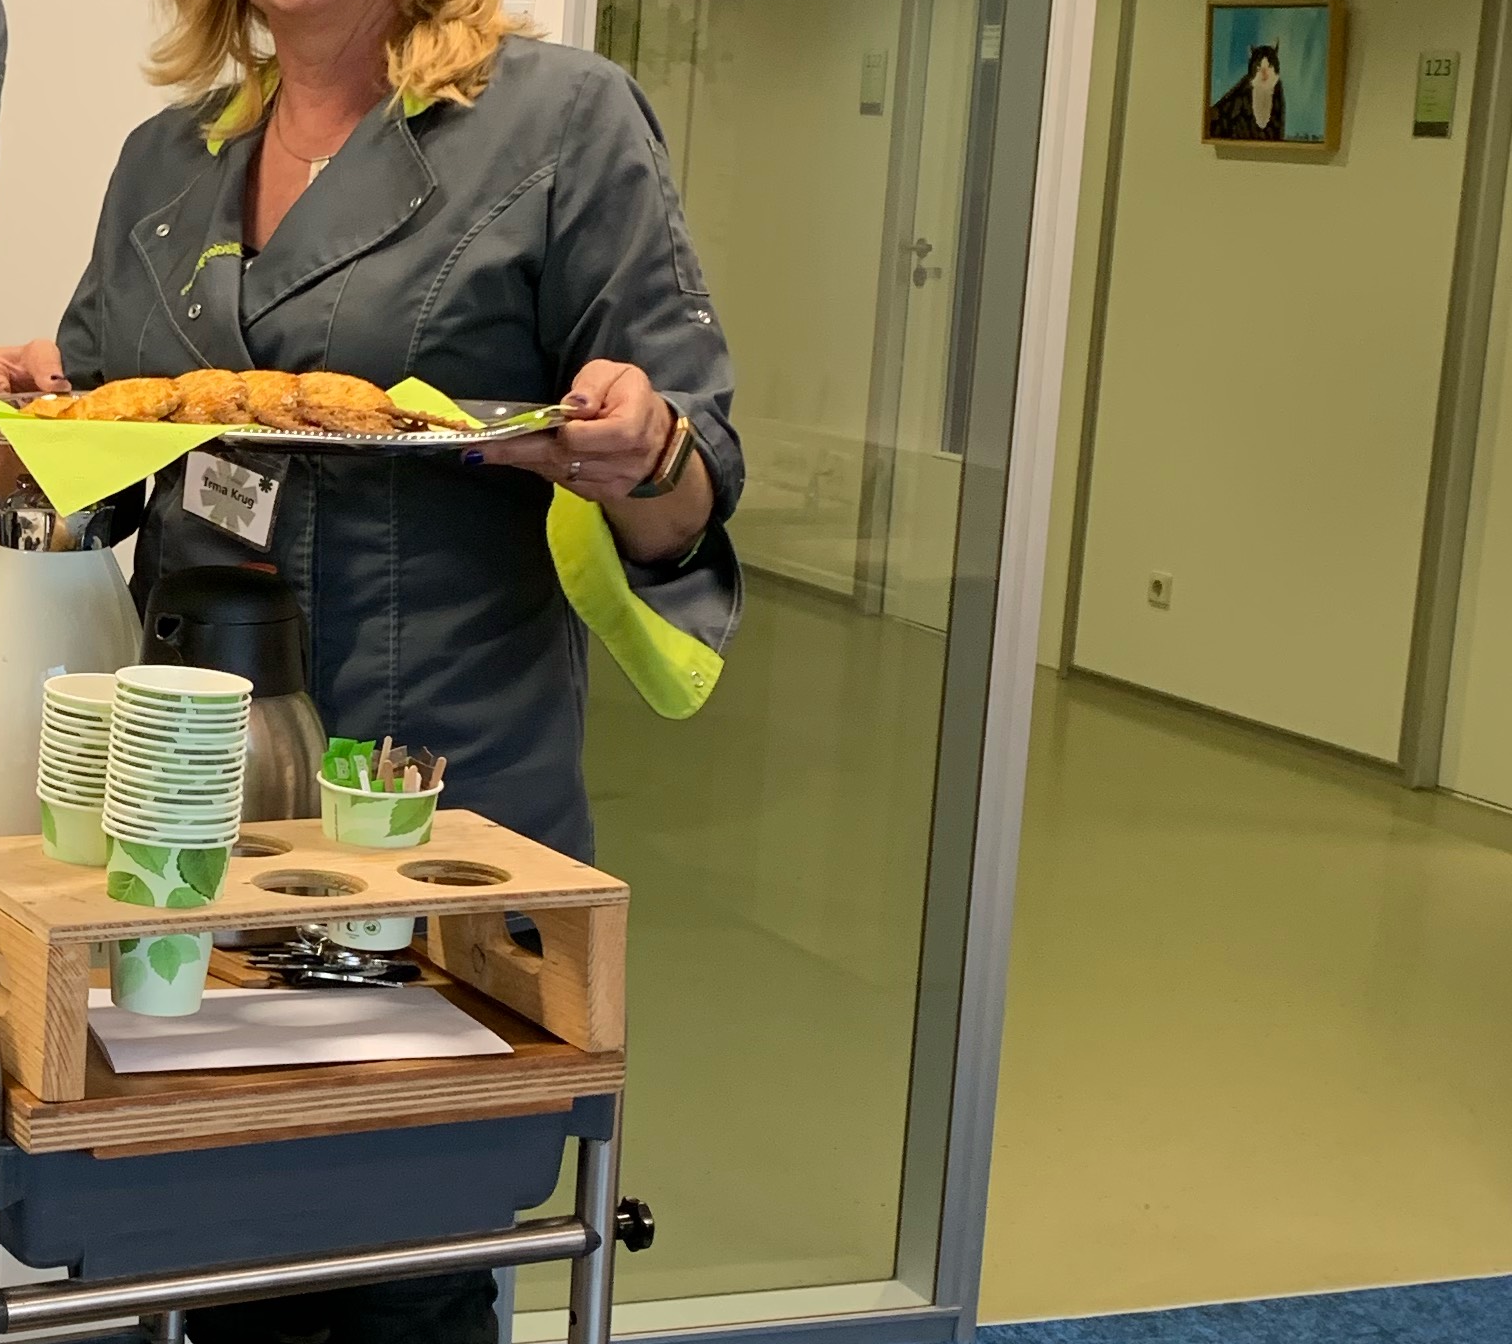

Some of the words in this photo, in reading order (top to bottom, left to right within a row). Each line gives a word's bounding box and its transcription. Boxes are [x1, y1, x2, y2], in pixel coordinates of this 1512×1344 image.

[1425, 59, 1452, 76] 123
[203, 477, 228, 496] Irma
[230, 488, 255, 510] Krug
